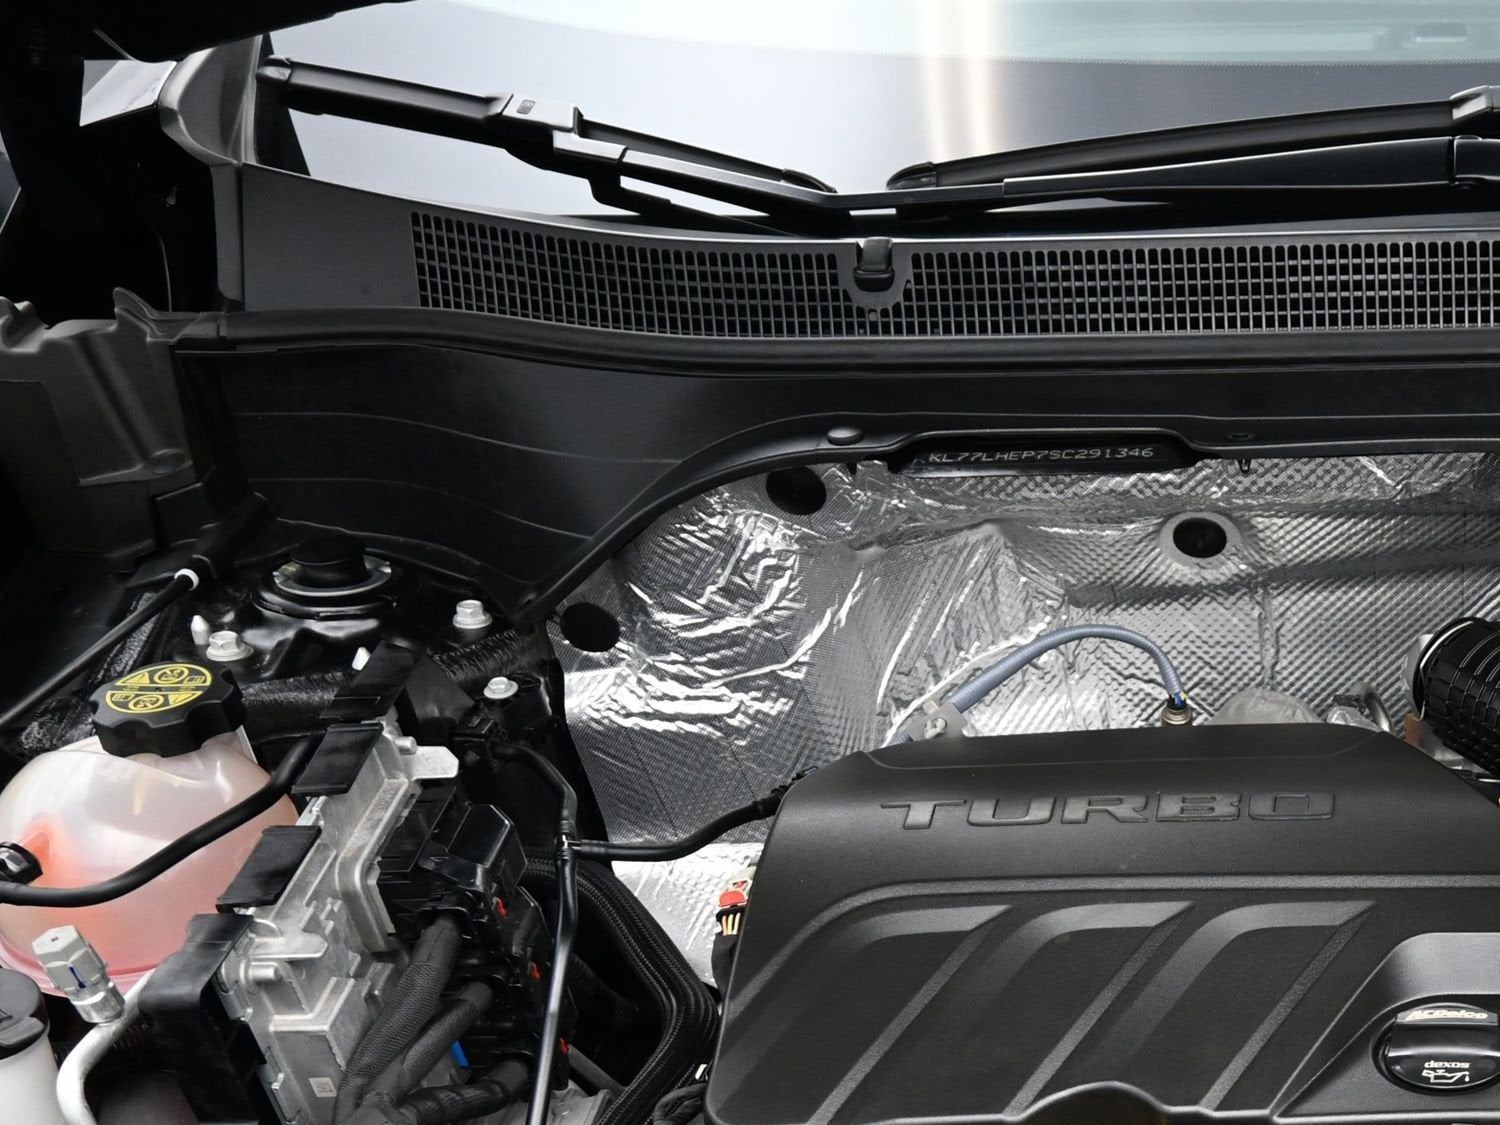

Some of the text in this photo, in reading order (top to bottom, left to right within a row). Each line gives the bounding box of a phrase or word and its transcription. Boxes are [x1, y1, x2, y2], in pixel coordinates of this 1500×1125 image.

[928, 447, 1154, 463] KL77LHEP7SC291346
[880, 790, 1337, 831] TURBO
[1406, 1009, 1488, 1020] ACDelco
[1424, 1060, 1471, 1069] dexos
